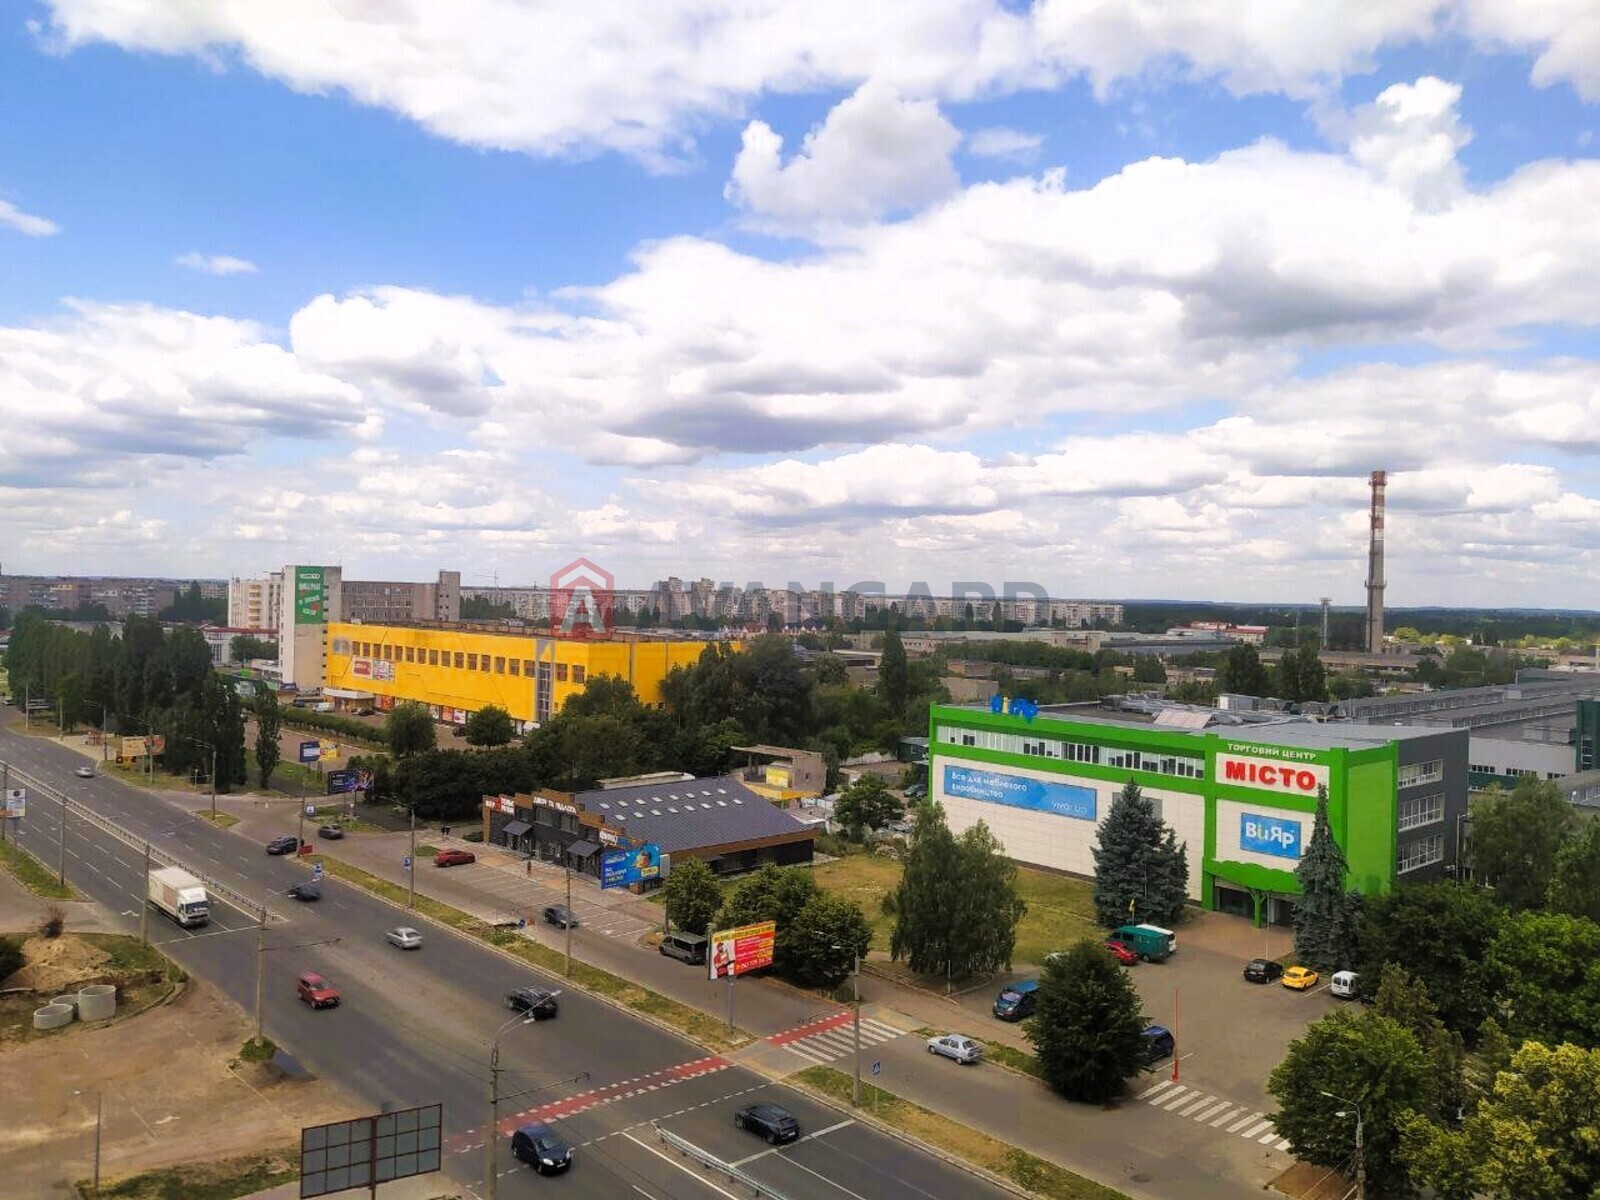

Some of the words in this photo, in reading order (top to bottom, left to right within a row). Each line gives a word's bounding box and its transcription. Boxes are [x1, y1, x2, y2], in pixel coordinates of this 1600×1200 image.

[1227, 743, 1280, 756] ТОРГОВИЙ
[1282, 750, 1316, 760] ЦЕНТР
[952, 771, 966, 780] Все
[1225, 761, 1316, 791] МІСТО
